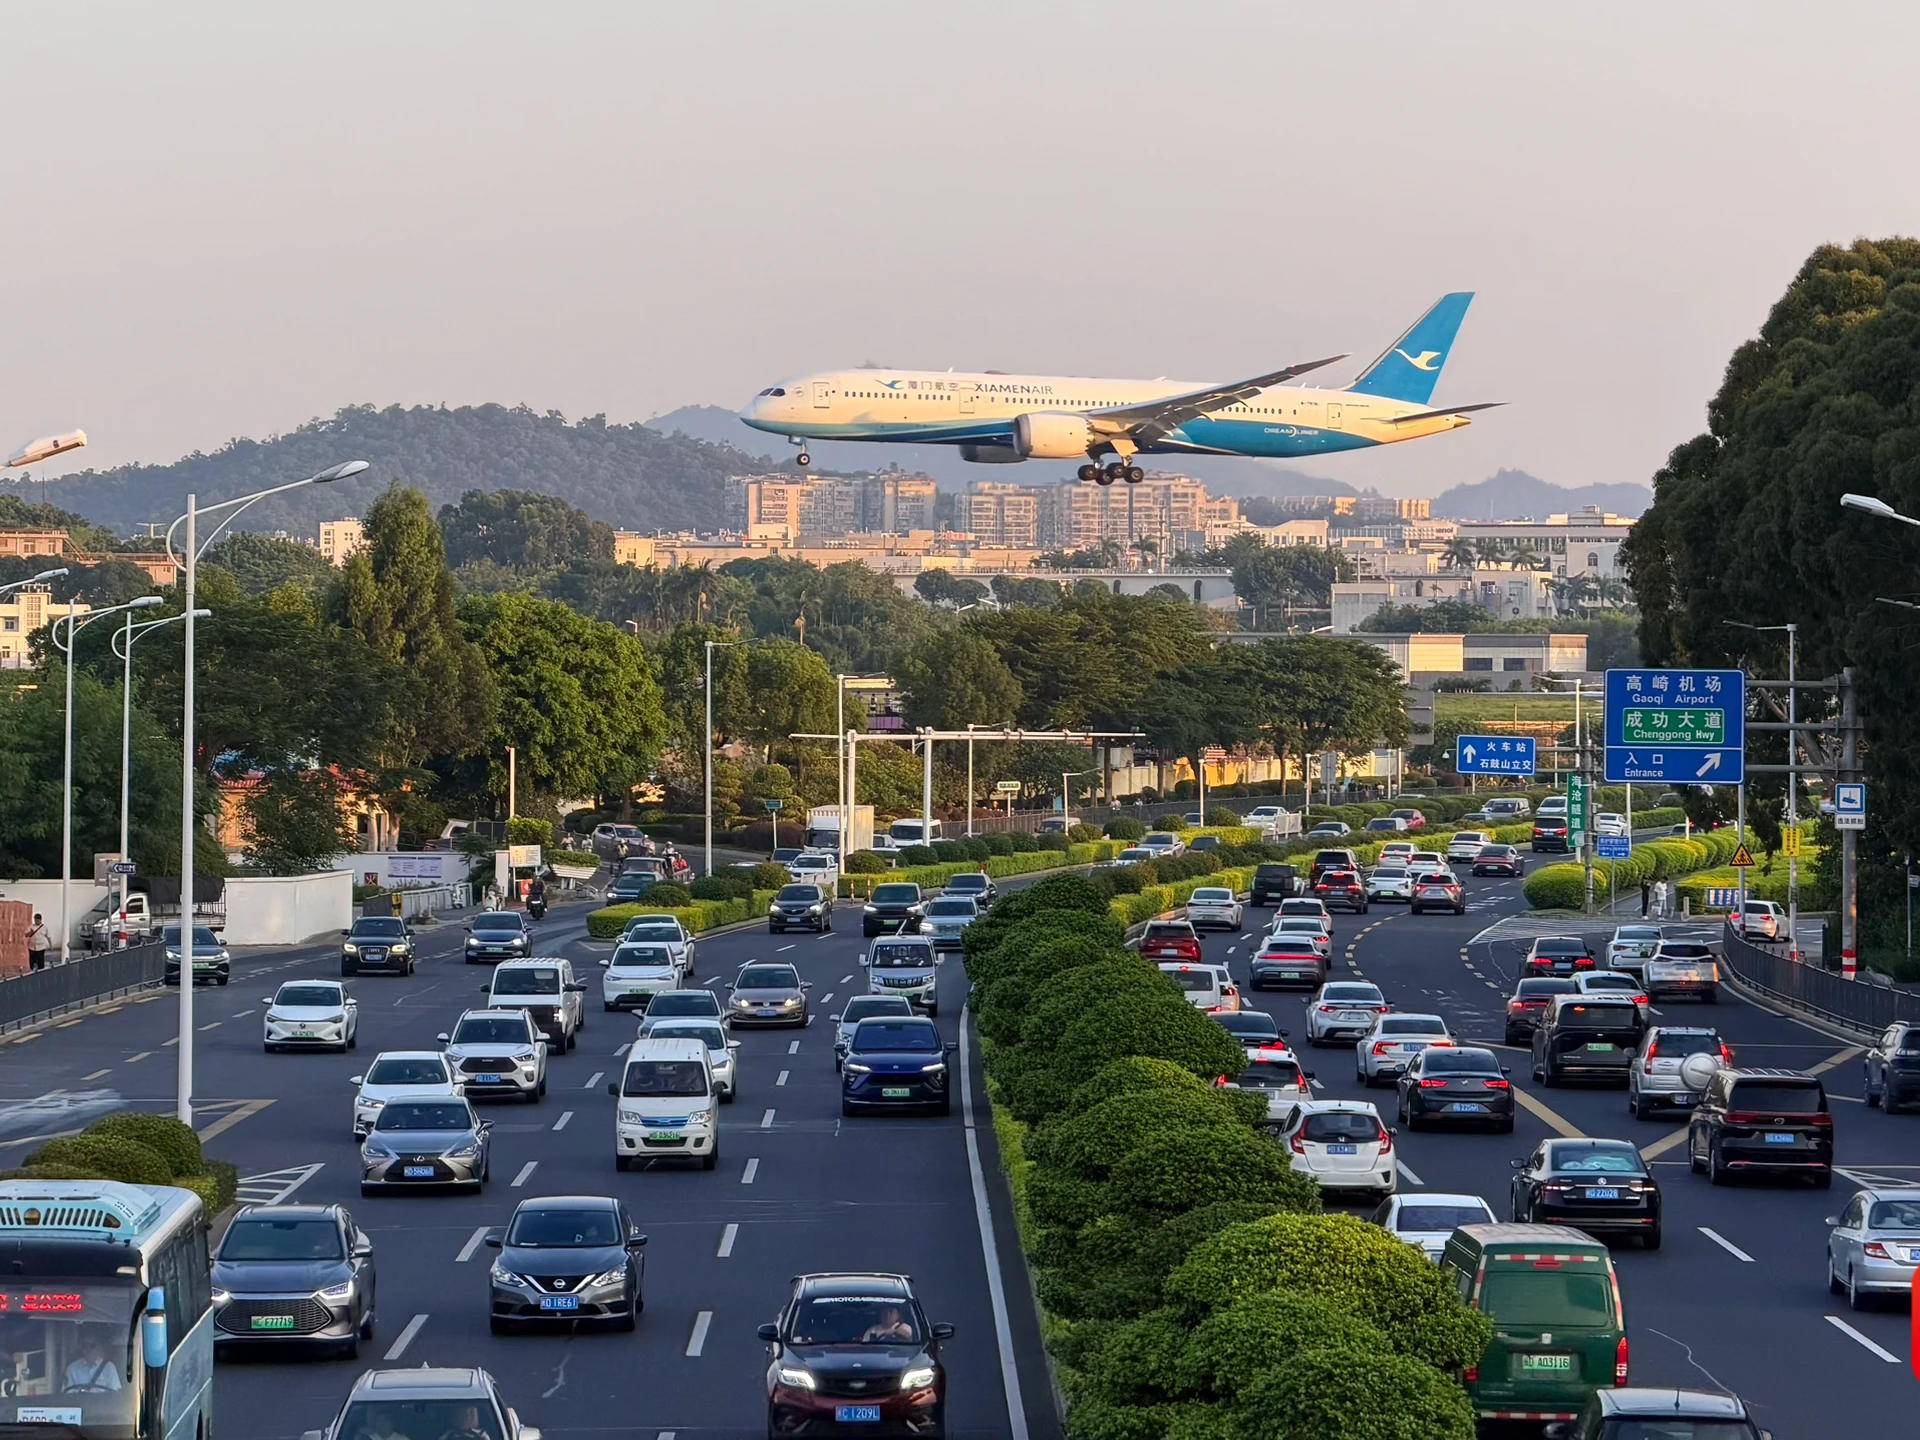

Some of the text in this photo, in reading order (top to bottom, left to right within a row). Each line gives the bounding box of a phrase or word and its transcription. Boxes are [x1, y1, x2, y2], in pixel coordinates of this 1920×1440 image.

[975, 383, 1053, 395] XIAMENAIR
[1626, 675, 1721, 692] 高崎机场
[1632, 694, 1714, 705] Gaoqi Airport
[1625, 711, 1721, 729] 成功大道
[1633, 729, 1714, 741] Chenggong Hwy
[1486, 741, 1527, 753] 火车站
[1625, 752, 1664, 764] 入口
[1624, 768, 1664, 777] Entrance
